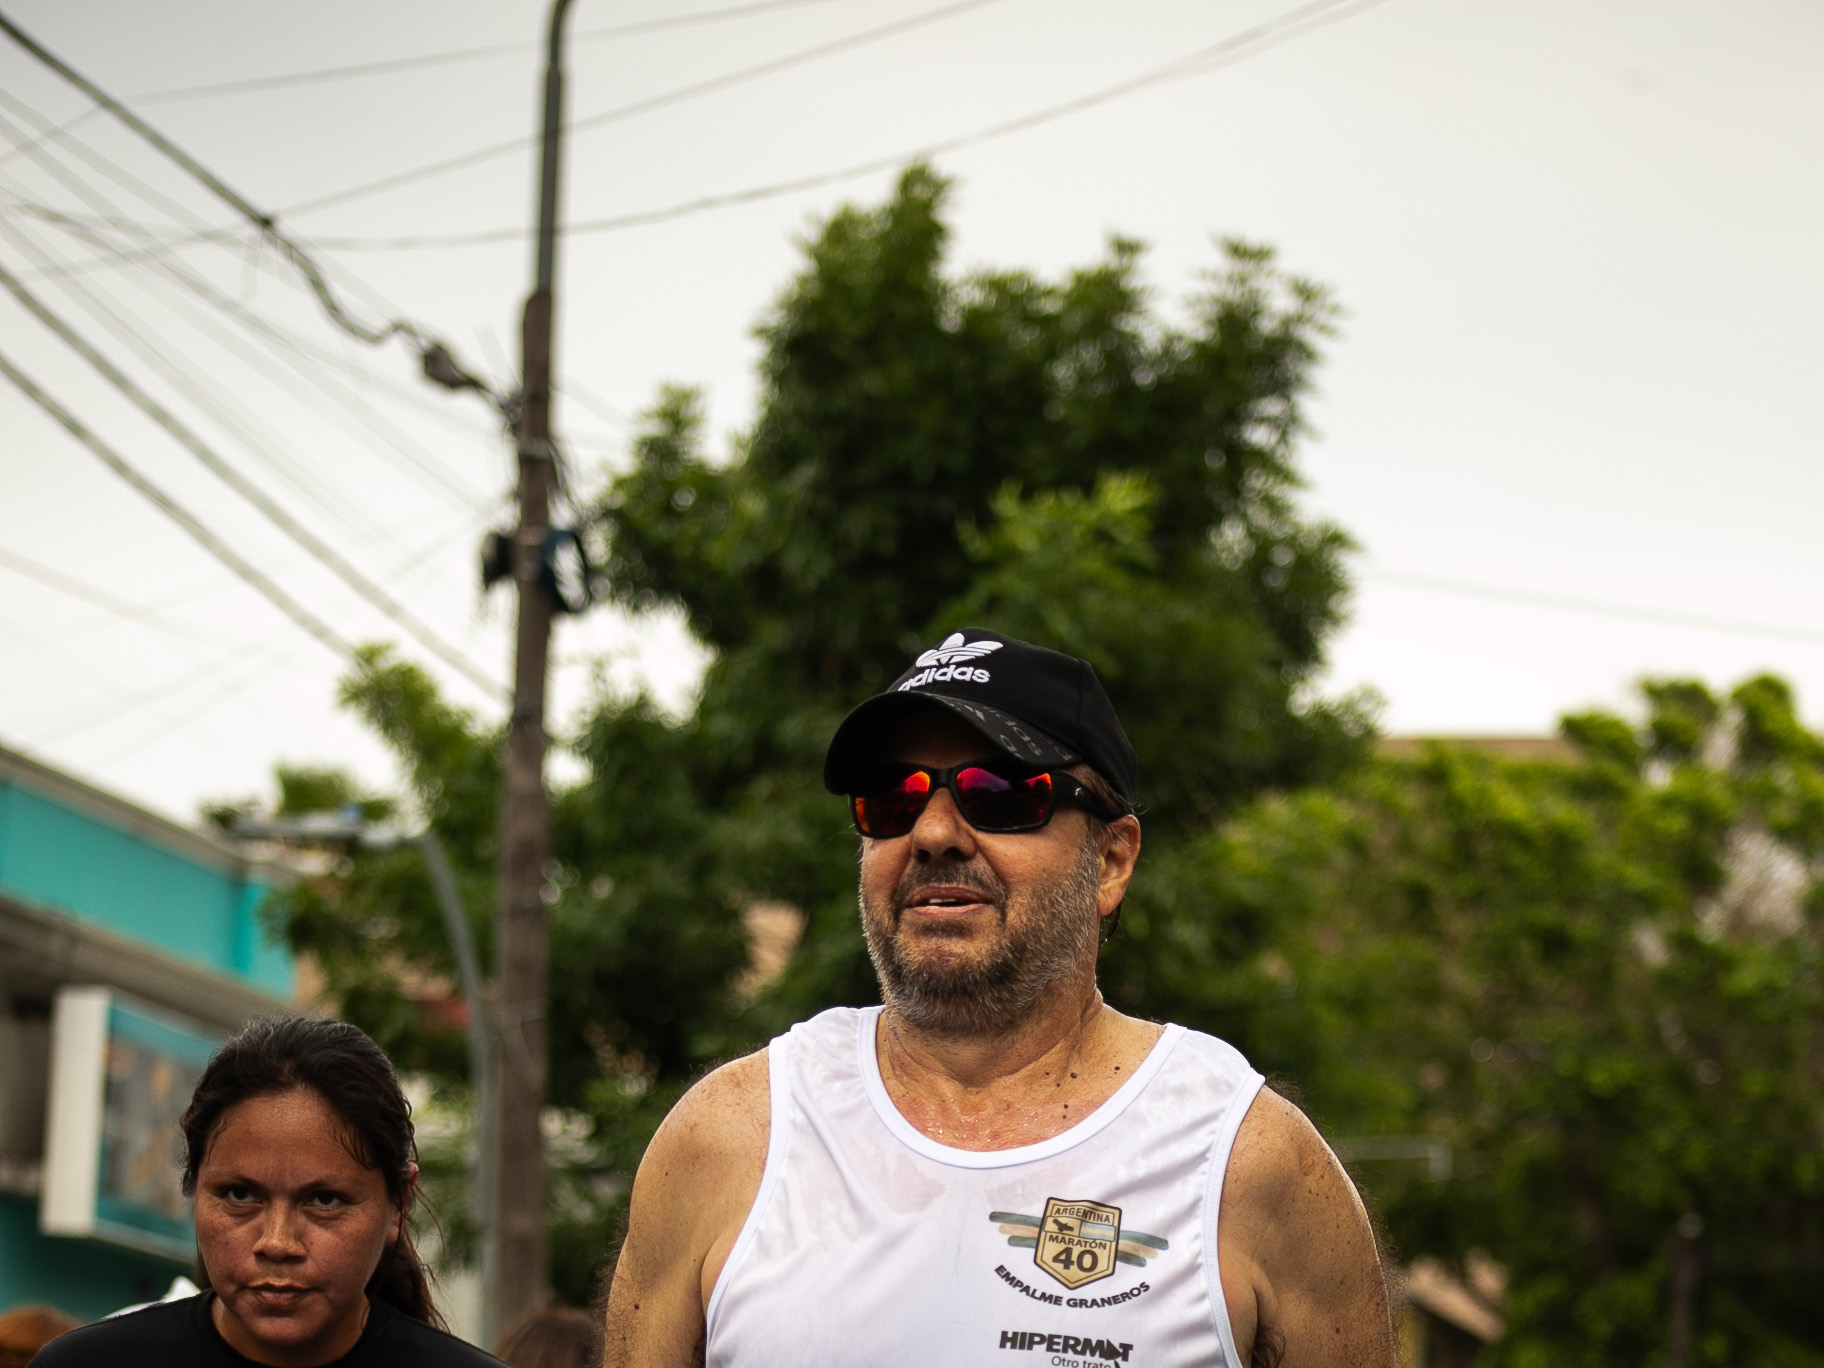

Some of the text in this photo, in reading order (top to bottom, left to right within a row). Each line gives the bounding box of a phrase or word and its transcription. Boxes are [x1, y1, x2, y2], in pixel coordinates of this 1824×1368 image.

[1054, 1207, 1110, 1223] ARGENTINA
[1048, 1234, 1106, 1249] MARATÓN
[1052, 1246, 1098, 1272] 40
[994, 1264, 1150, 1308] EMPALME GRANEROS
[1051, 1355, 1079, 1368] Otro
